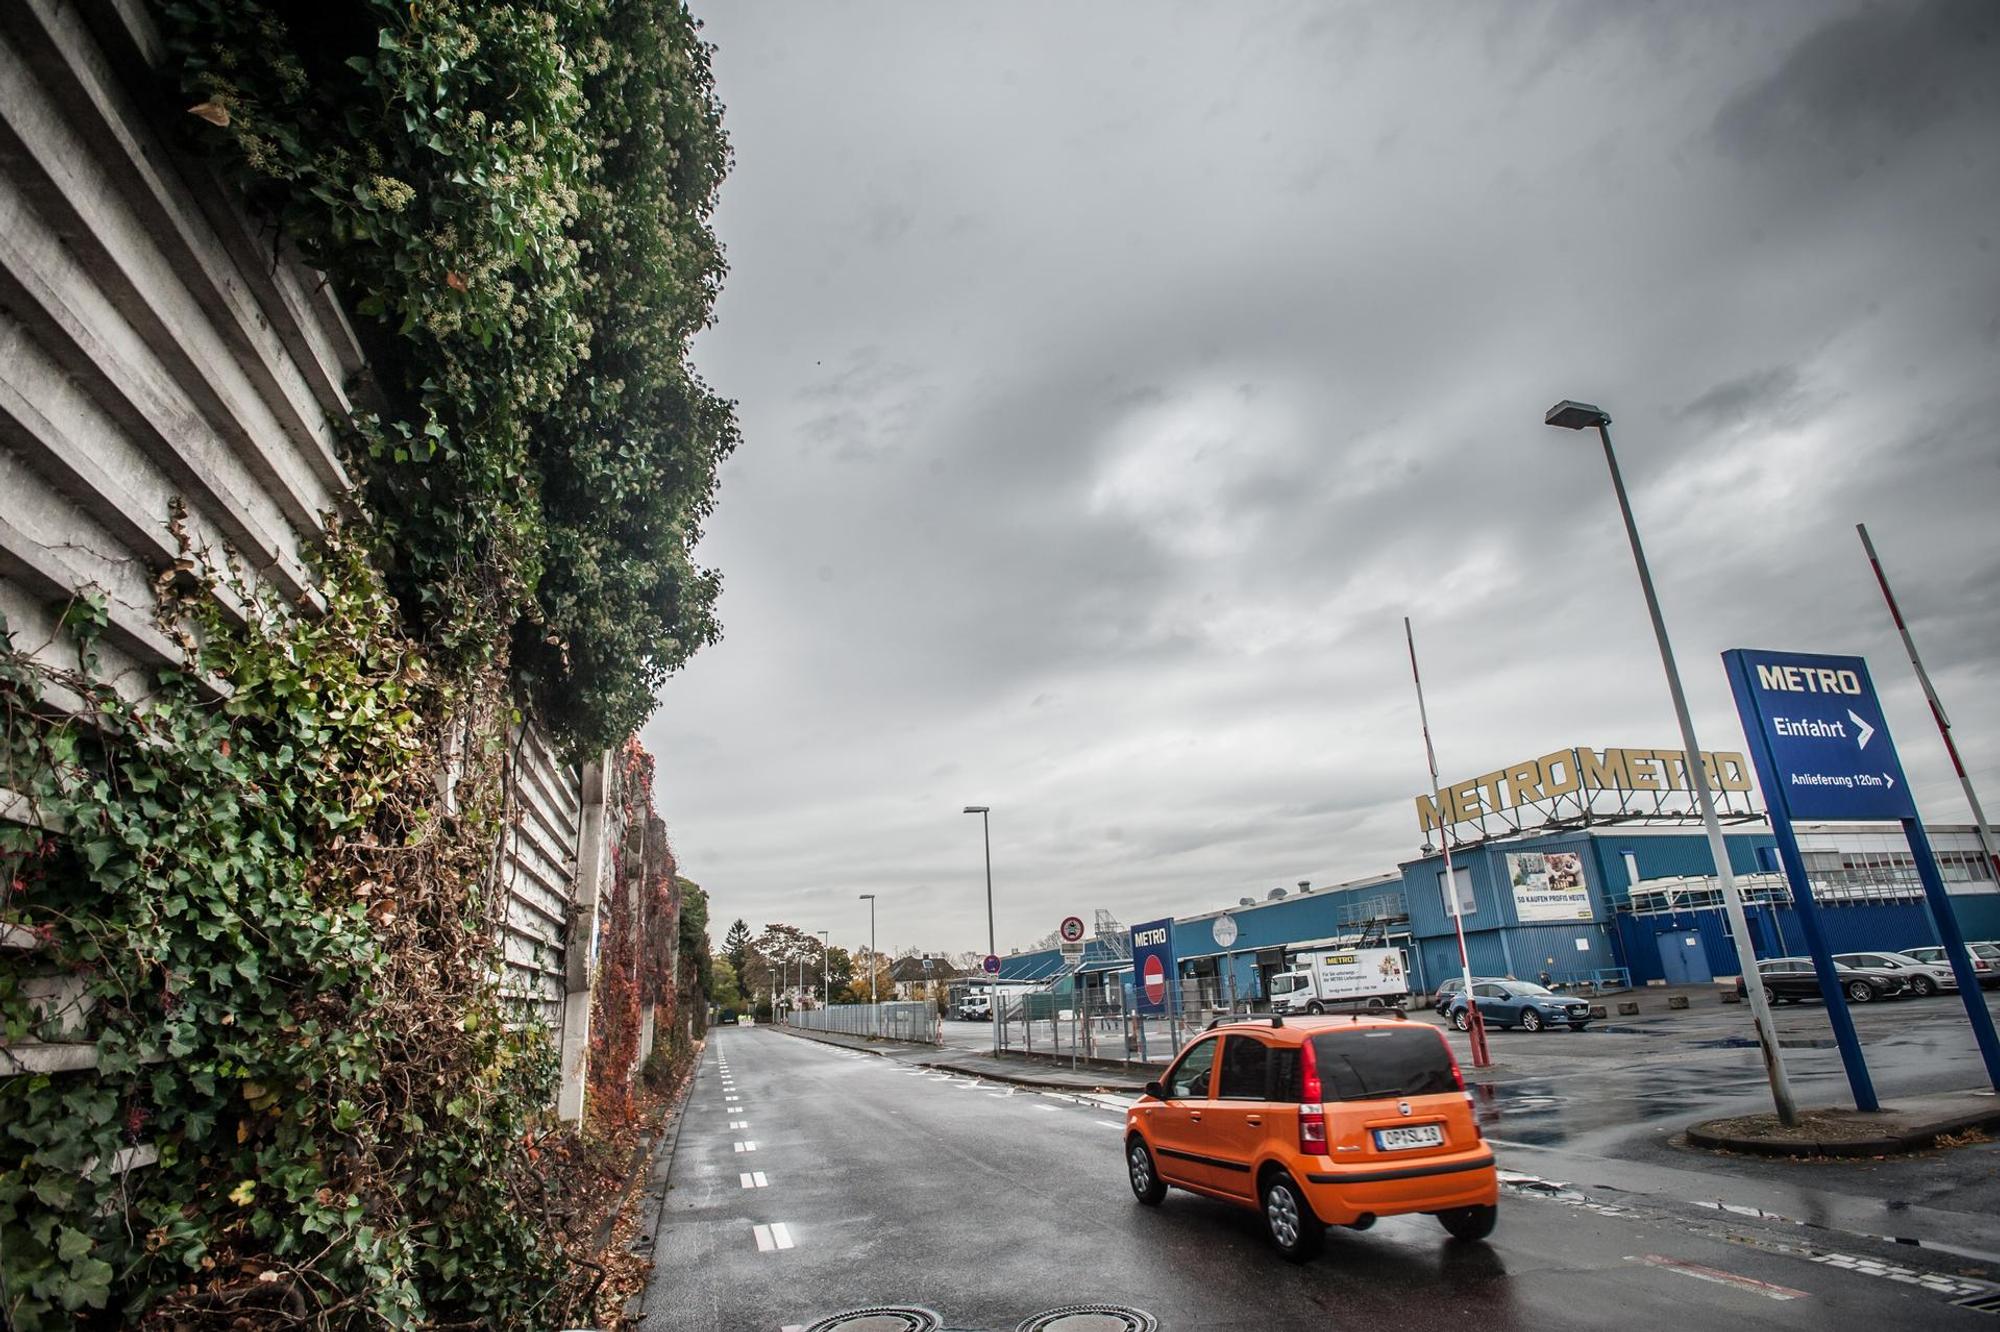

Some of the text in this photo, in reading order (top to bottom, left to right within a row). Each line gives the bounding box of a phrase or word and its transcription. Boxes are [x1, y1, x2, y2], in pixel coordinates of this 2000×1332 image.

[1756, 665, 1861, 695] METRO
[1773, 717, 1847, 738] Einfahrt
[1415, 748, 1581, 832] METRO
[1791, 773, 1882, 788] Anlieferung 120m
[1549, 894, 1568, 902] PROFIS
[1135, 928, 1166, 947] METRO
[1327, 956, 1353, 964] METRO
